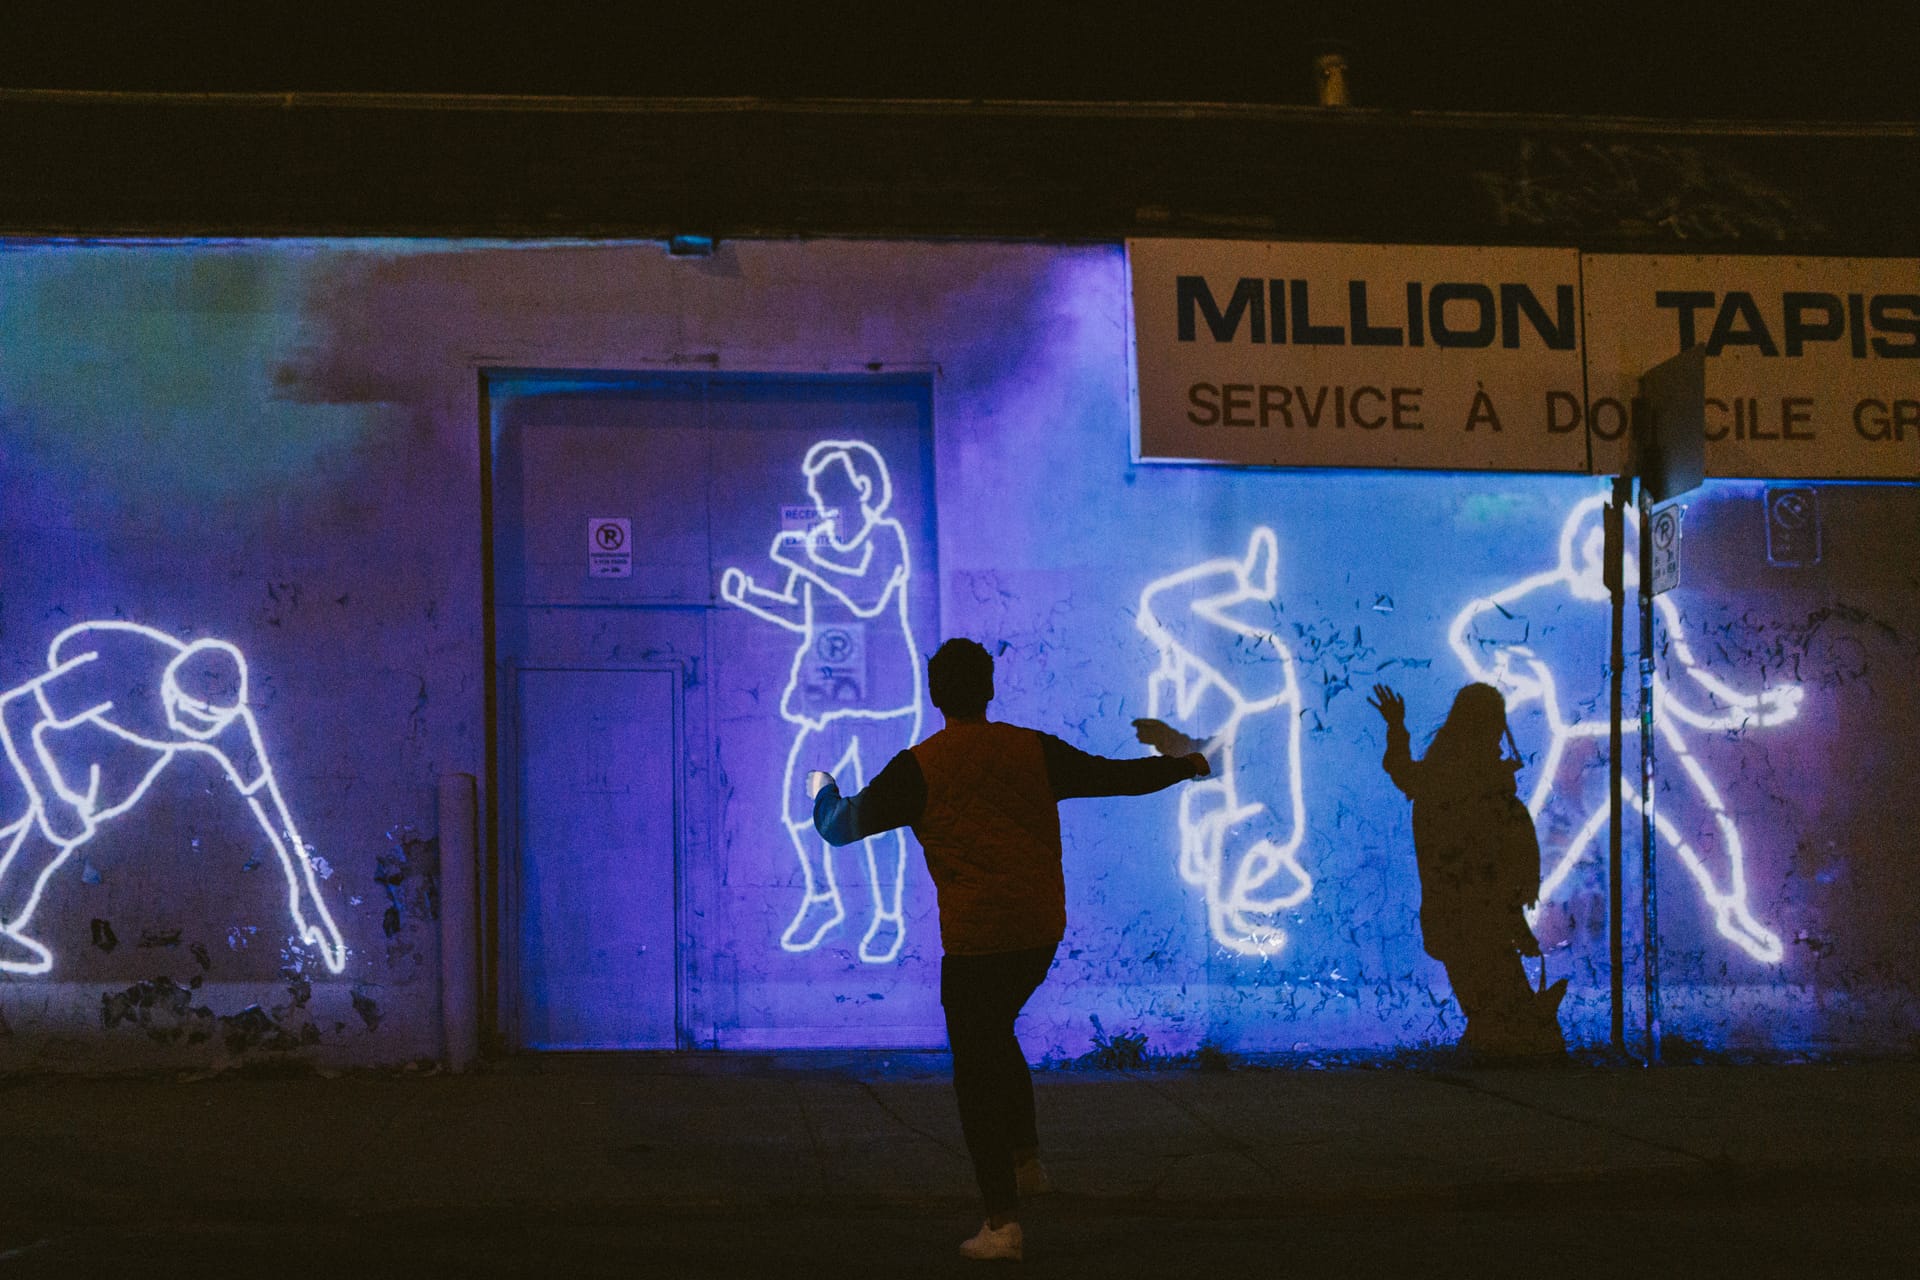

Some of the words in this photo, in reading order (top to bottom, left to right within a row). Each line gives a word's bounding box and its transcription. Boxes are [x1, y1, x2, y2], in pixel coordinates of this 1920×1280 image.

[1176, 275, 1575, 351] MILLION
[1655, 290, 1920, 360] TAPIS
[1187, 382, 1424, 431] SERVICE
[1465, 381, 1502, 432] À
[1546, 390, 1816, 442] DOCILE
